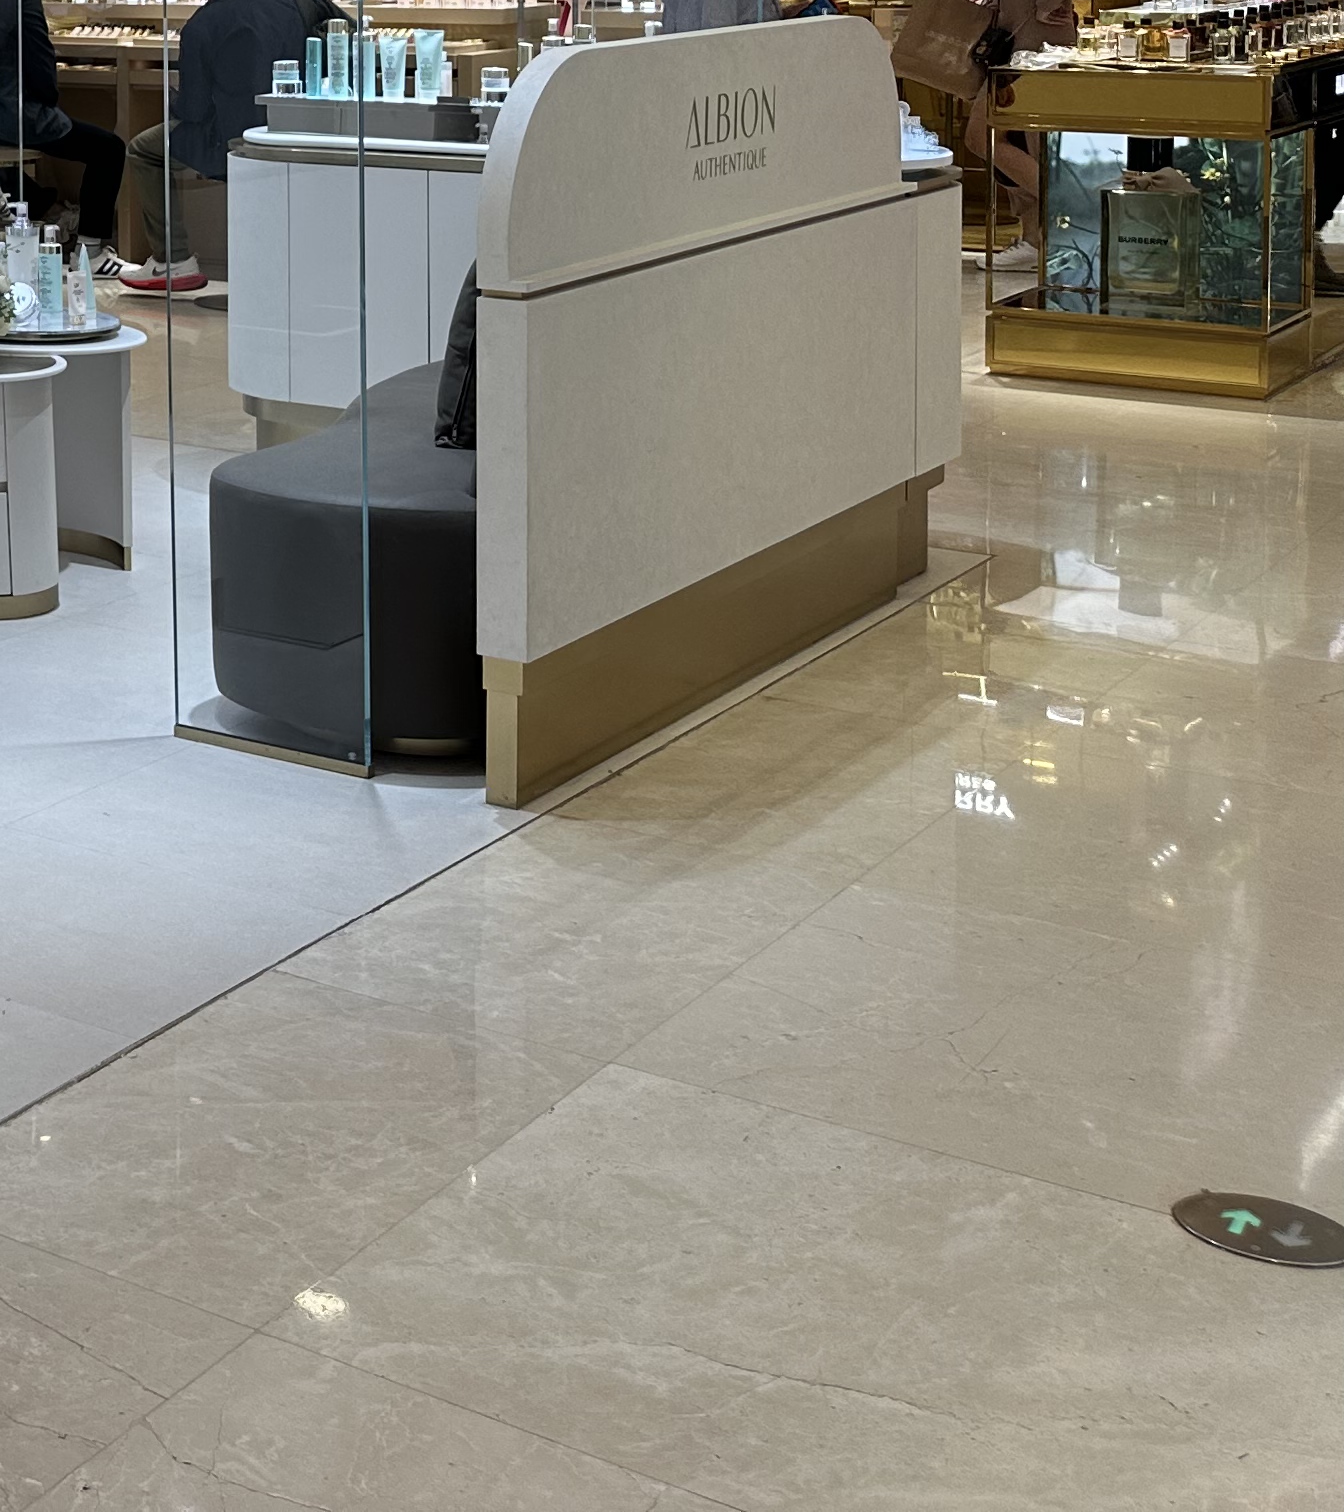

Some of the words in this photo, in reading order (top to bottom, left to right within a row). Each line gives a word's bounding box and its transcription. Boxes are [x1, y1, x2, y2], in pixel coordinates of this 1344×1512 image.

[685, 84, 776, 149] ALBION
[692, 147, 768, 181] AUTHENTIQUE
[1117, 235, 1169, 247] BURBERRY
